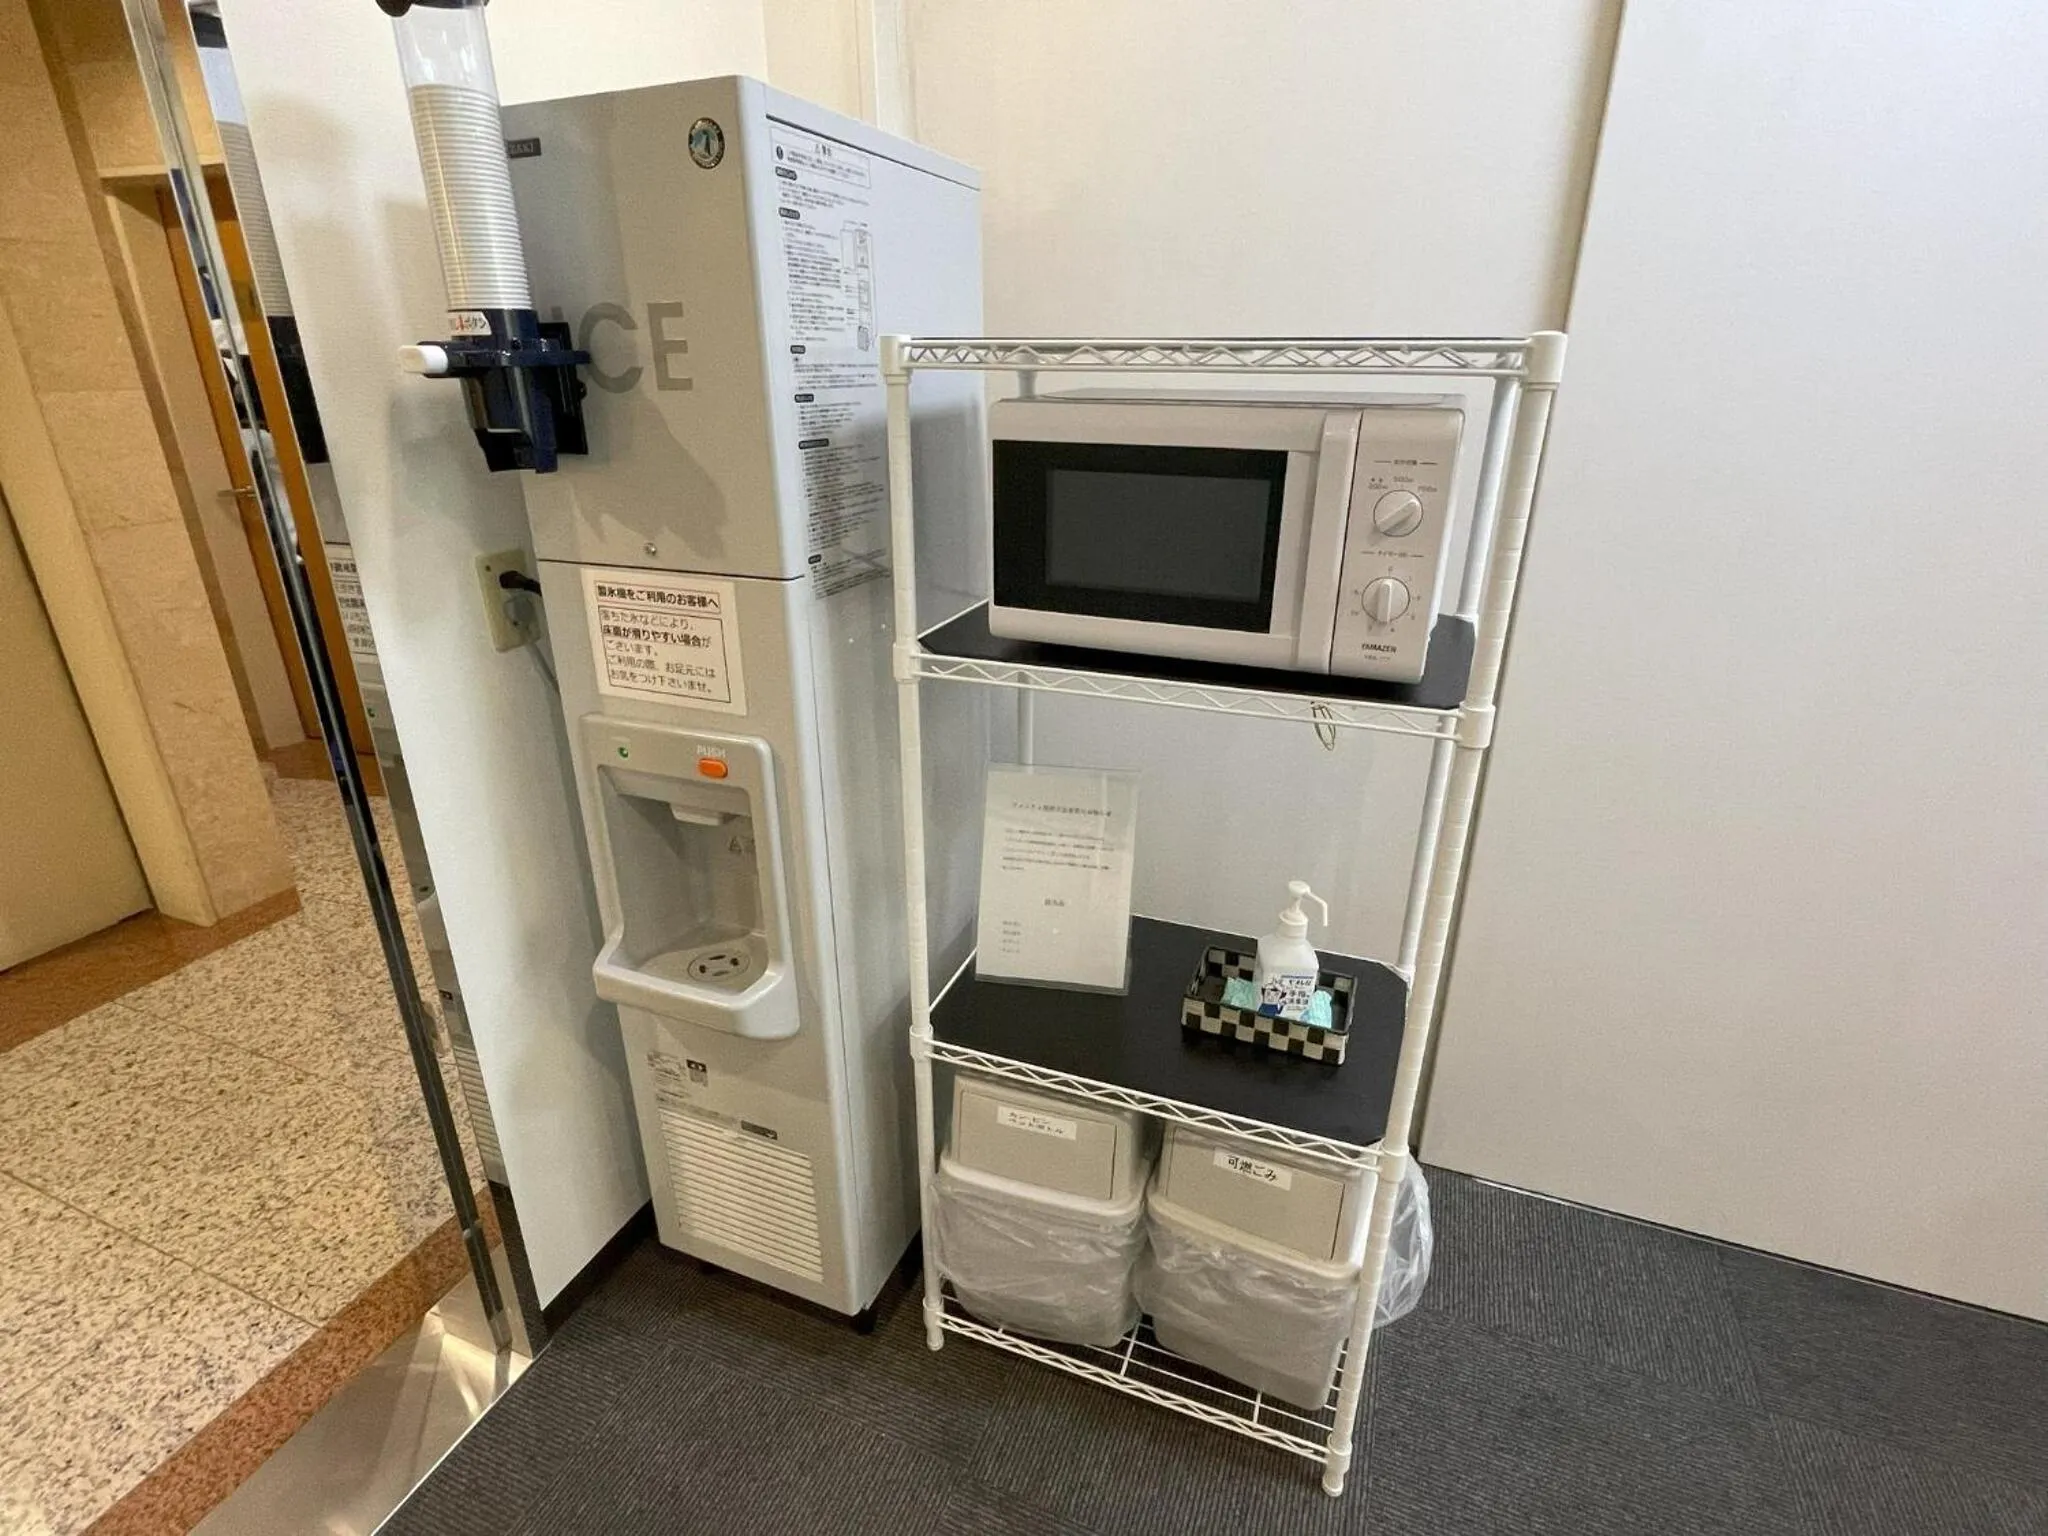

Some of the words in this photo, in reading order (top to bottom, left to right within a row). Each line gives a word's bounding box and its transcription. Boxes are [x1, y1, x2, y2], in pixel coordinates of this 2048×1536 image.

[551, 302, 692, 394] CE
[602, 624, 712, 648] 床面が滑りやすい場合が
[610, 669, 712, 694] お気をつけ下さいませ。
[1228, 1156, 1276, 1182] 可燃ごみ
